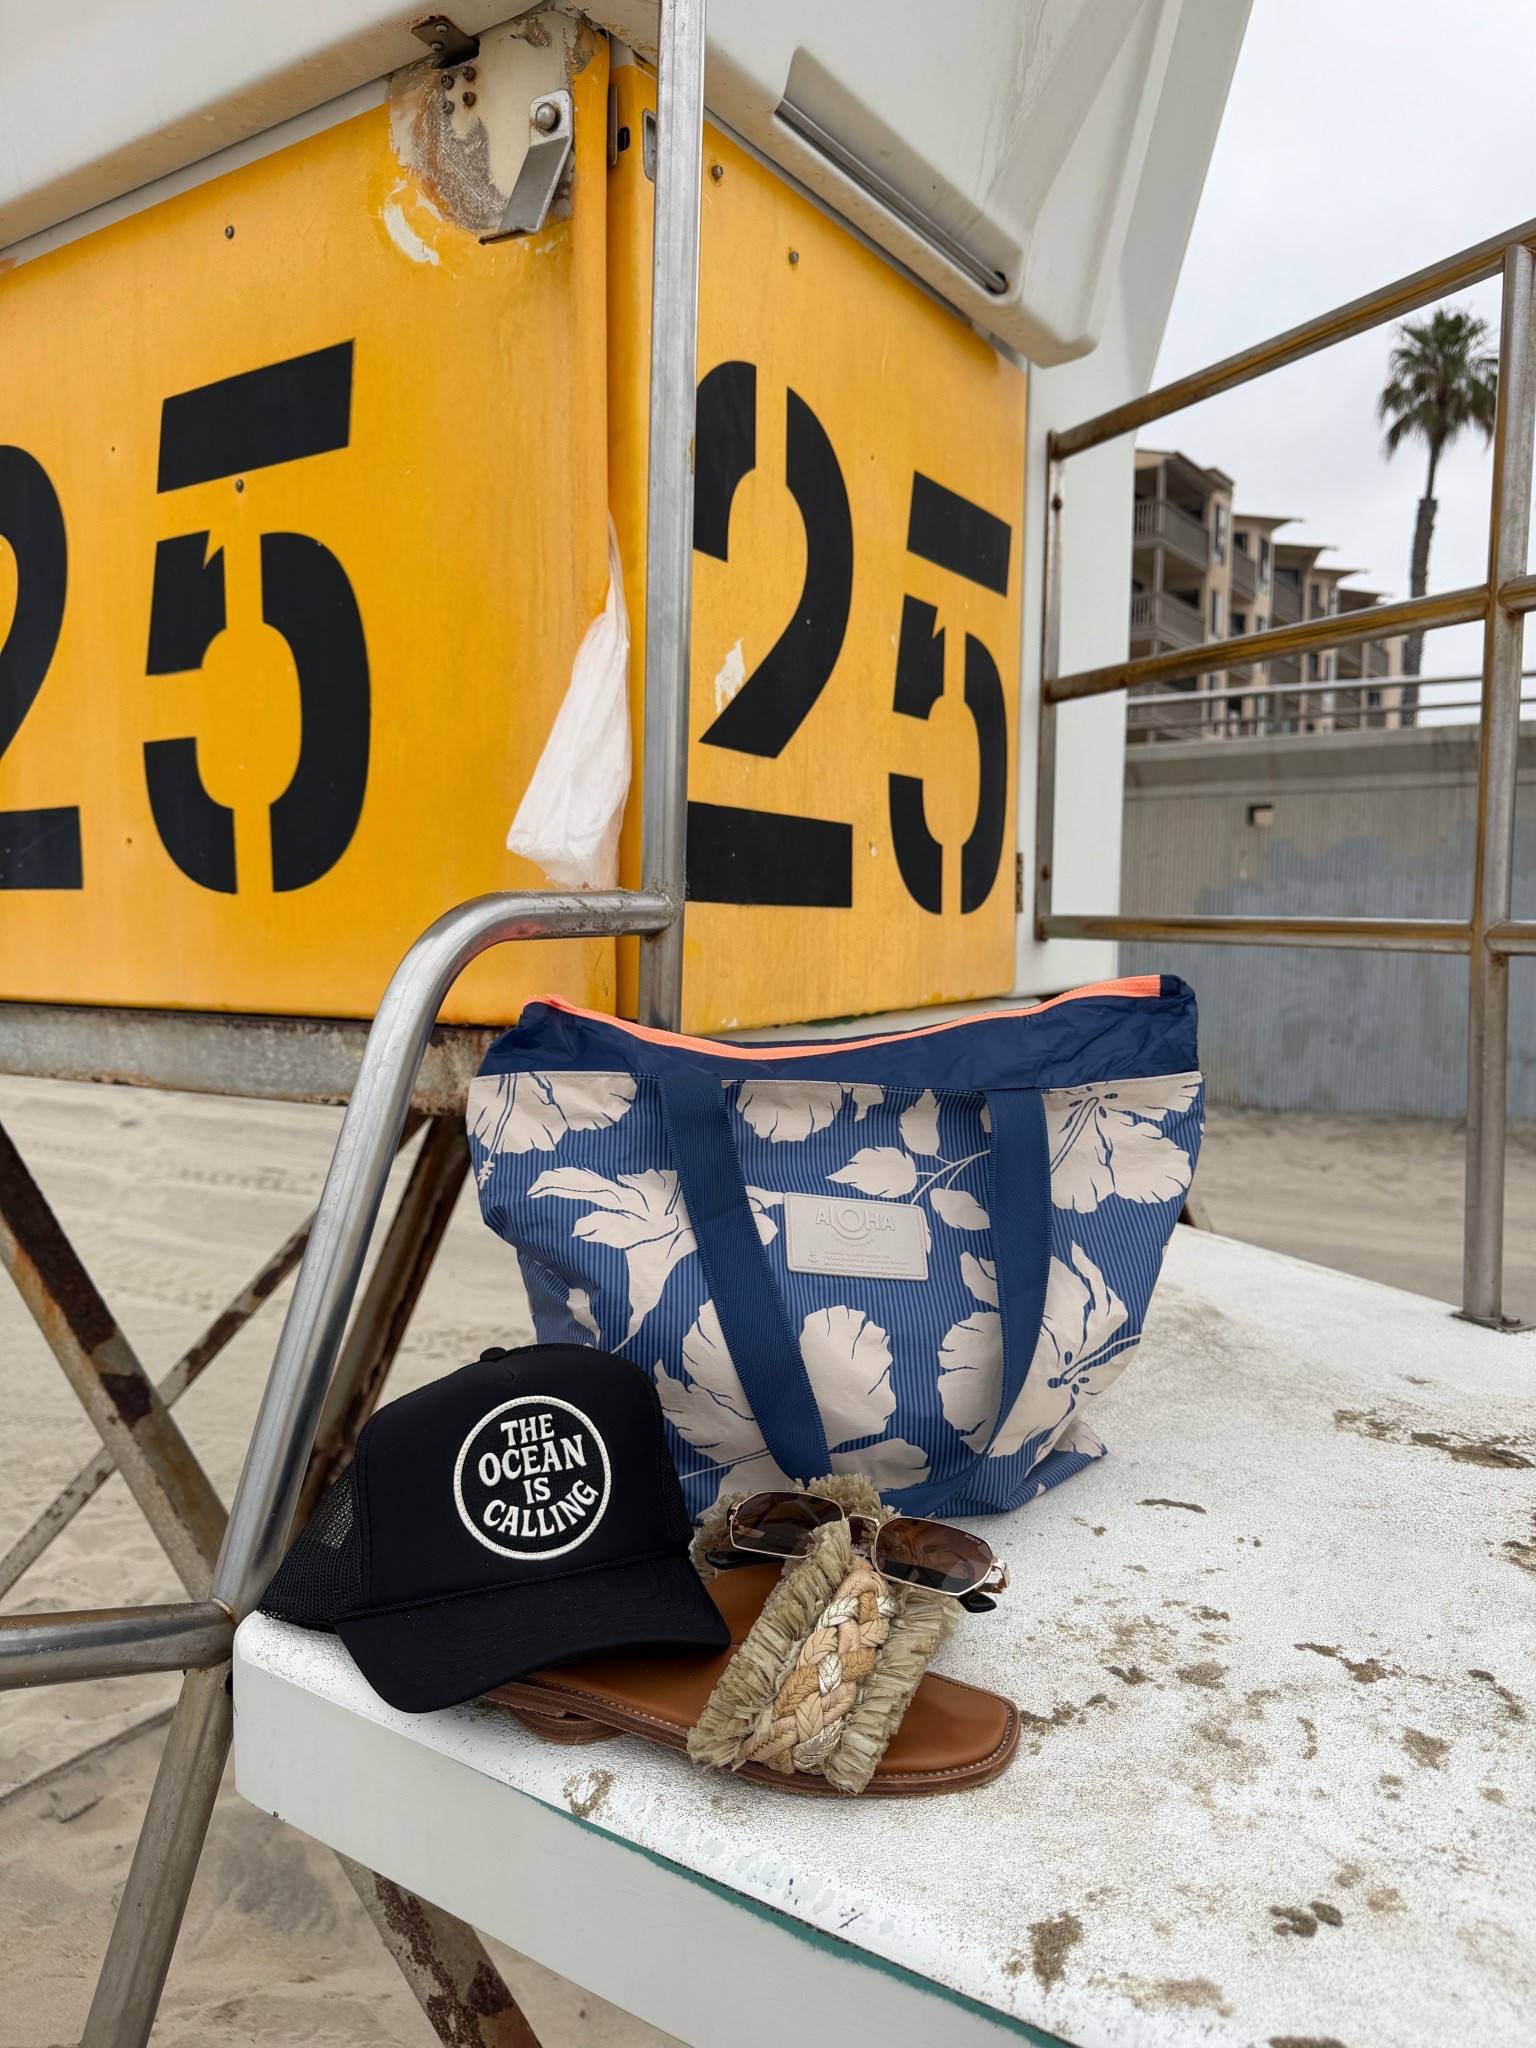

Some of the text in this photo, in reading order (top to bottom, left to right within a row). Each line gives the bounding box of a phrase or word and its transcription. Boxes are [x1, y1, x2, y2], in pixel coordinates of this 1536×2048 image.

[685, 360, 1012, 915] 25
[815, 1203, 896, 1240] ALOHA
[500, 1413, 555, 1447] THE
[478, 1434, 588, 1487] OCEAN
[483, 1479, 600, 1537] CALLING
[522, 1477, 551, 1504] IS
